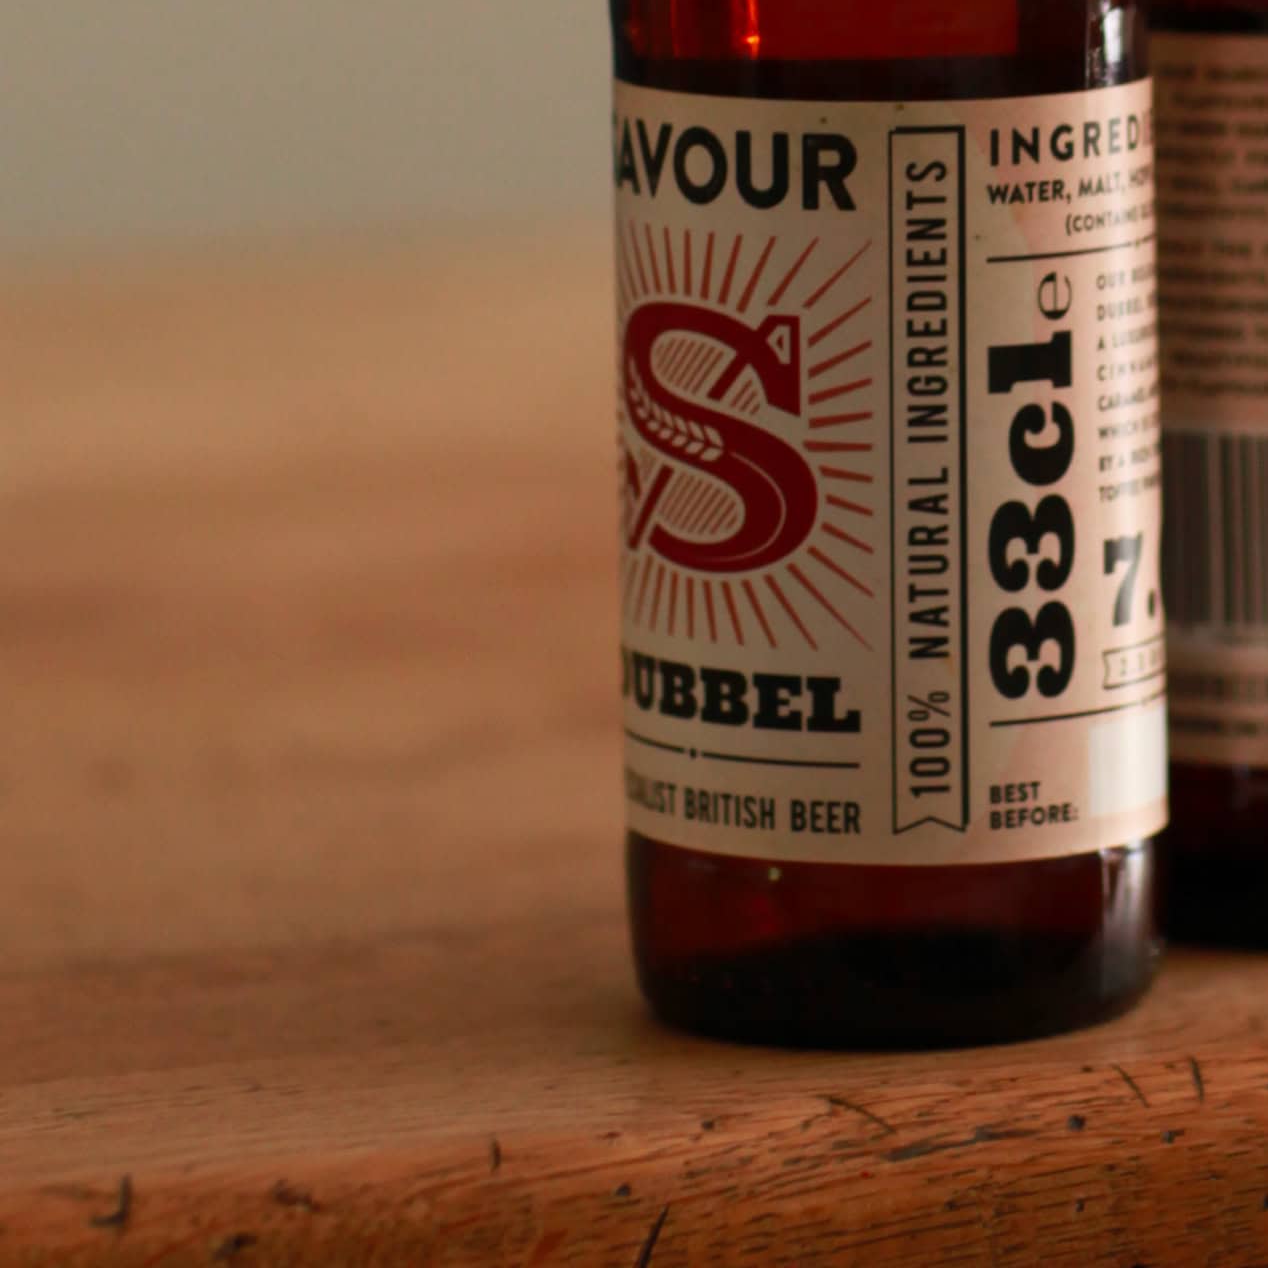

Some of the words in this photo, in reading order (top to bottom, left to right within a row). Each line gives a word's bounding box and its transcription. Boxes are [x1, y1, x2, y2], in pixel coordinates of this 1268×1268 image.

[613, 112, 857, 211] AVOUR
[986, 179, 1072, 205] WATER,
[905, 160, 948, 444] INGREDIENTS
[907, 466, 950, 661] NATURAL
[907, 690, 951, 799] 100%
[684, 784, 775, 831] BRITISH
[790, 798, 861, 835] BEER
[989, 781, 1041, 805] BEST
[989, 803, 1079, 831] BEFORE:
